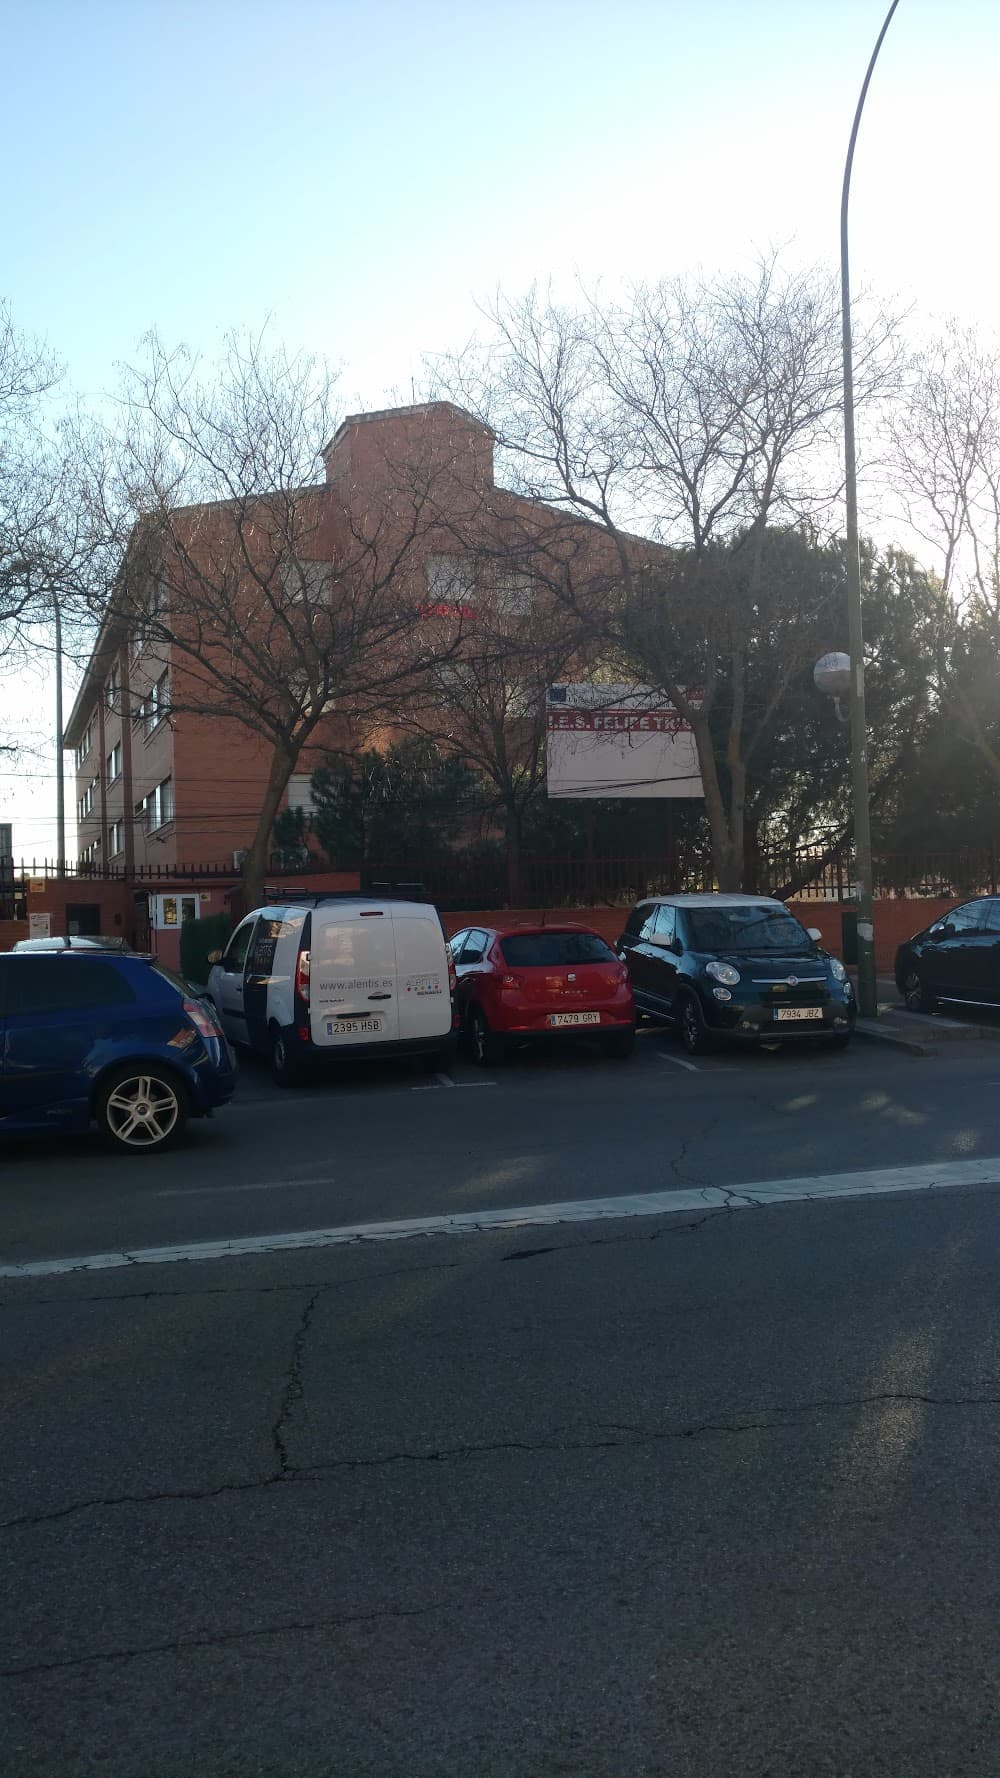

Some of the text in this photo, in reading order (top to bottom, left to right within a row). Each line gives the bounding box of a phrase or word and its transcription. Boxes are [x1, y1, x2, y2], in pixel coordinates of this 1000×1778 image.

[593, 716, 649, 729] FELIPE
[320, 979, 393, 990] www.alentis.es
[557, 1014, 579, 1024] 7479
[780, 1008, 819, 1019] 7934 JBZ
[333, 1020, 380, 1033] 2395 HSB
